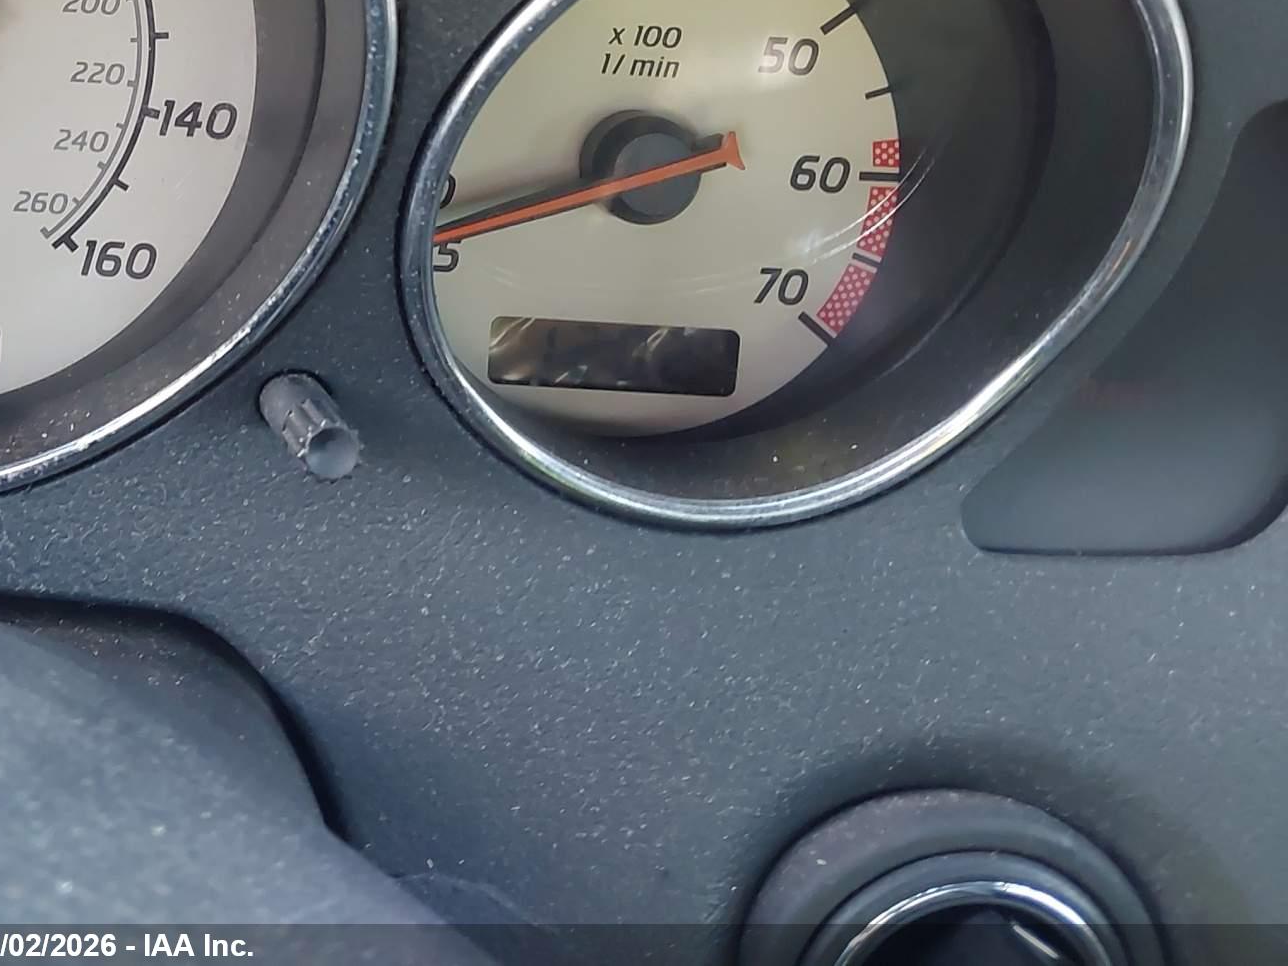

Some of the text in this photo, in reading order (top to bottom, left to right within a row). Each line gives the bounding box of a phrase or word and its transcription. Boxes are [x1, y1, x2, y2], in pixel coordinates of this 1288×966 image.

[634, 25, 682, 49] 100
[70, 61, 125, 85] 220
[758, 37, 820, 77] 50
[159, 100, 238, 140] 140
[53, 129, 109, 153] 240
[789, 155, 851, 195] 60
[13, 191, 68, 214] 260
[81, 240, 157, 280] 160
[753, 267, 809, 306] 70
